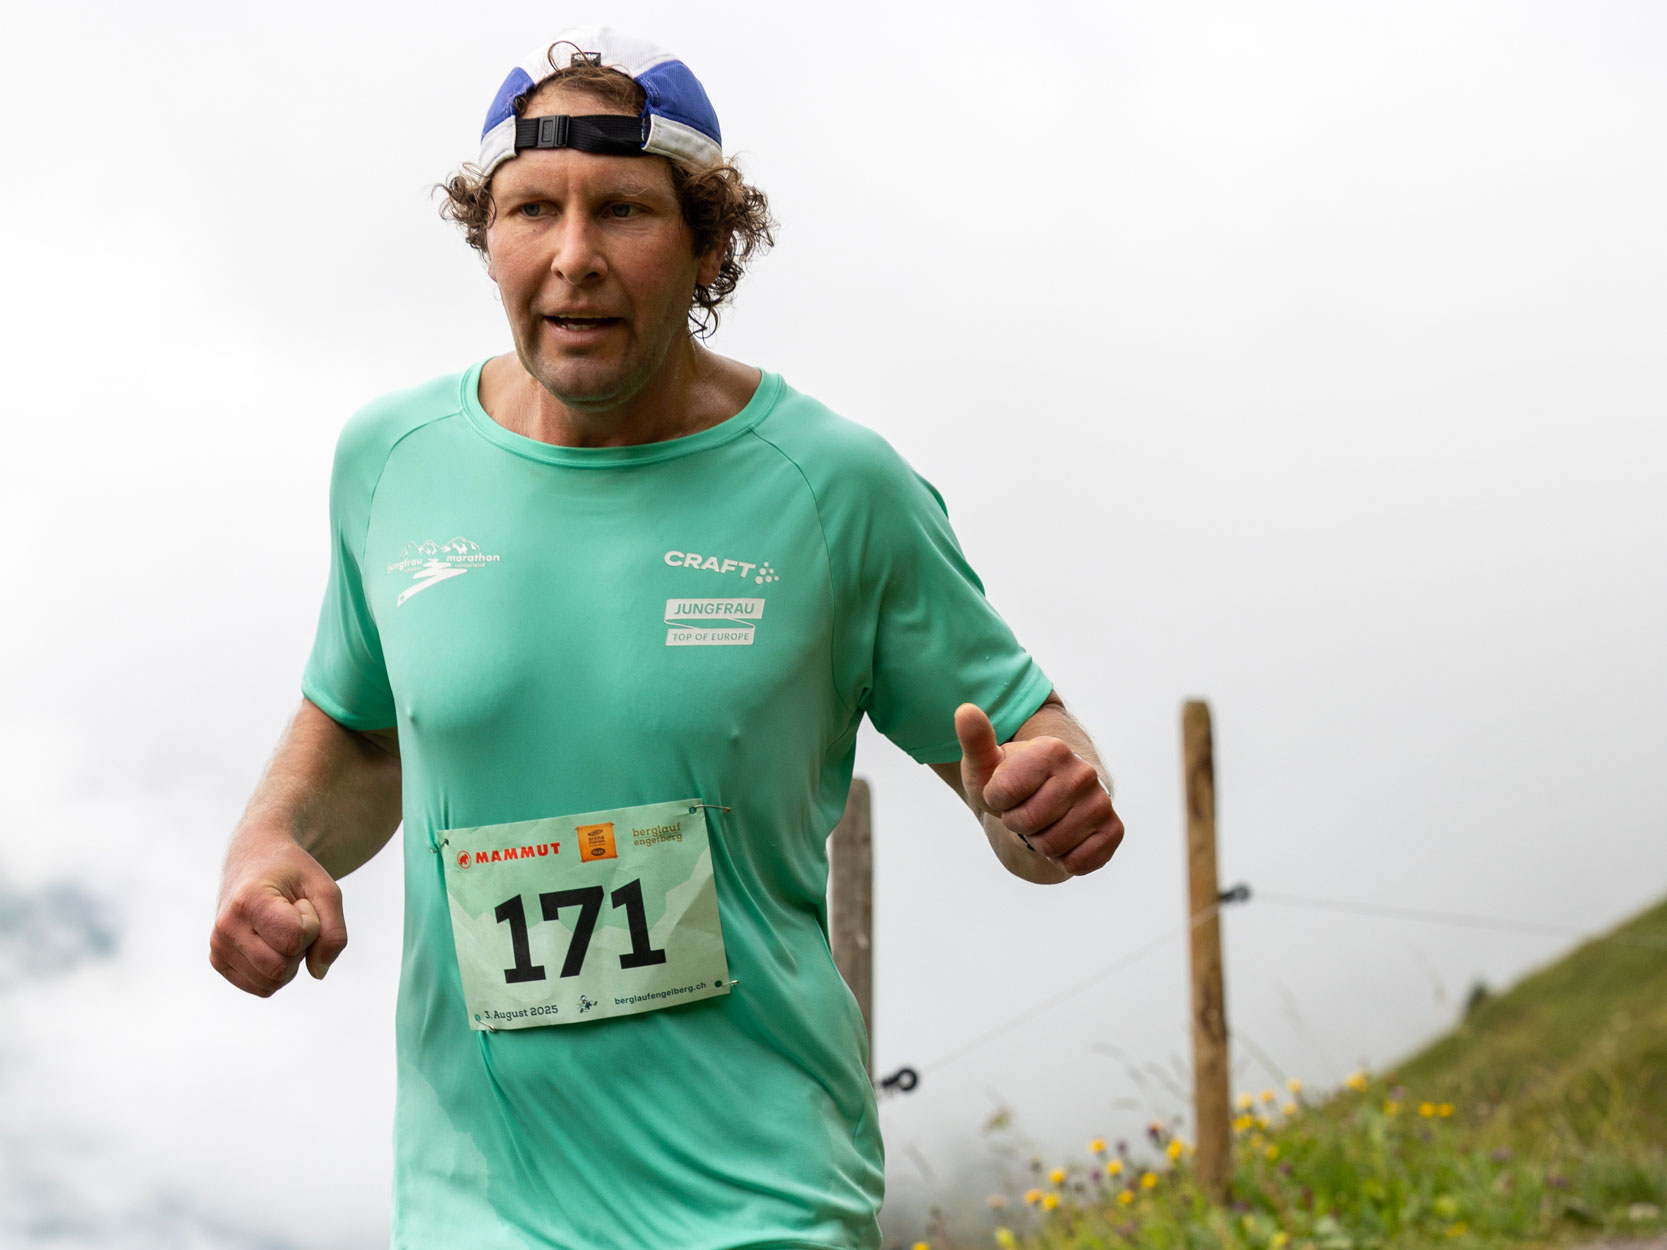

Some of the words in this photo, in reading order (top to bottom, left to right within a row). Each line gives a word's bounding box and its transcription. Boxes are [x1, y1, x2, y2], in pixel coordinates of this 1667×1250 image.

[446, 552, 500, 562] marathon
[664, 550, 756, 578] CRAFT
[674, 602, 755, 615] JUNGFRAU
[672, 633, 692, 641] TOP
[695, 633, 708, 641] OF
[711, 632, 750, 641] EUROPE
[632, 821, 681, 837] berglauf
[633, 833, 683, 847] engelberg
[475, 842, 560, 864] MAMMUT
[494, 877, 667, 984] 171
[614, 981, 707, 1005] berglaufengelberg.ch
[484, 1010, 493, 1020] 3.
[493, 1009, 529, 1022] August
[529, 1004, 559, 1016] 2025
